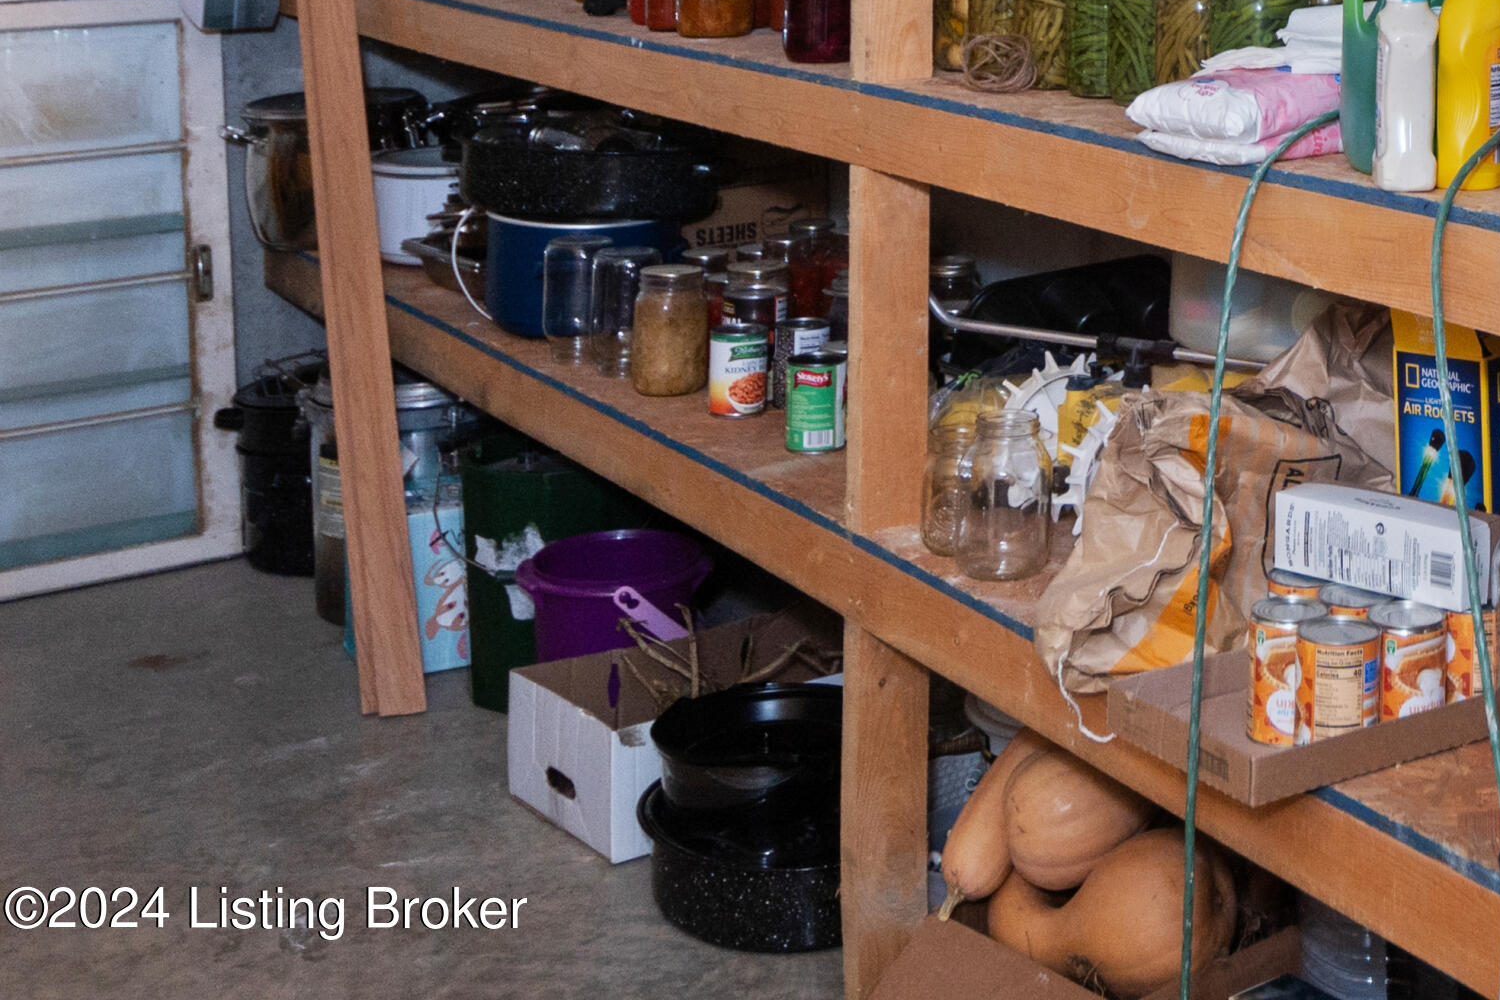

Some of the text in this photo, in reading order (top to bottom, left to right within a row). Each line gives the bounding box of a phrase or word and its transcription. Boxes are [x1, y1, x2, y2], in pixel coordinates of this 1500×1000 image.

[695, 222, 757, 246] SHEETS
[724, 365, 759, 375] KIDNEY
[1403, 401, 1422, 416] AIR
[1316, 648, 1344, 657] Nutrition
[1316, 669, 1363, 679] Calories 40
